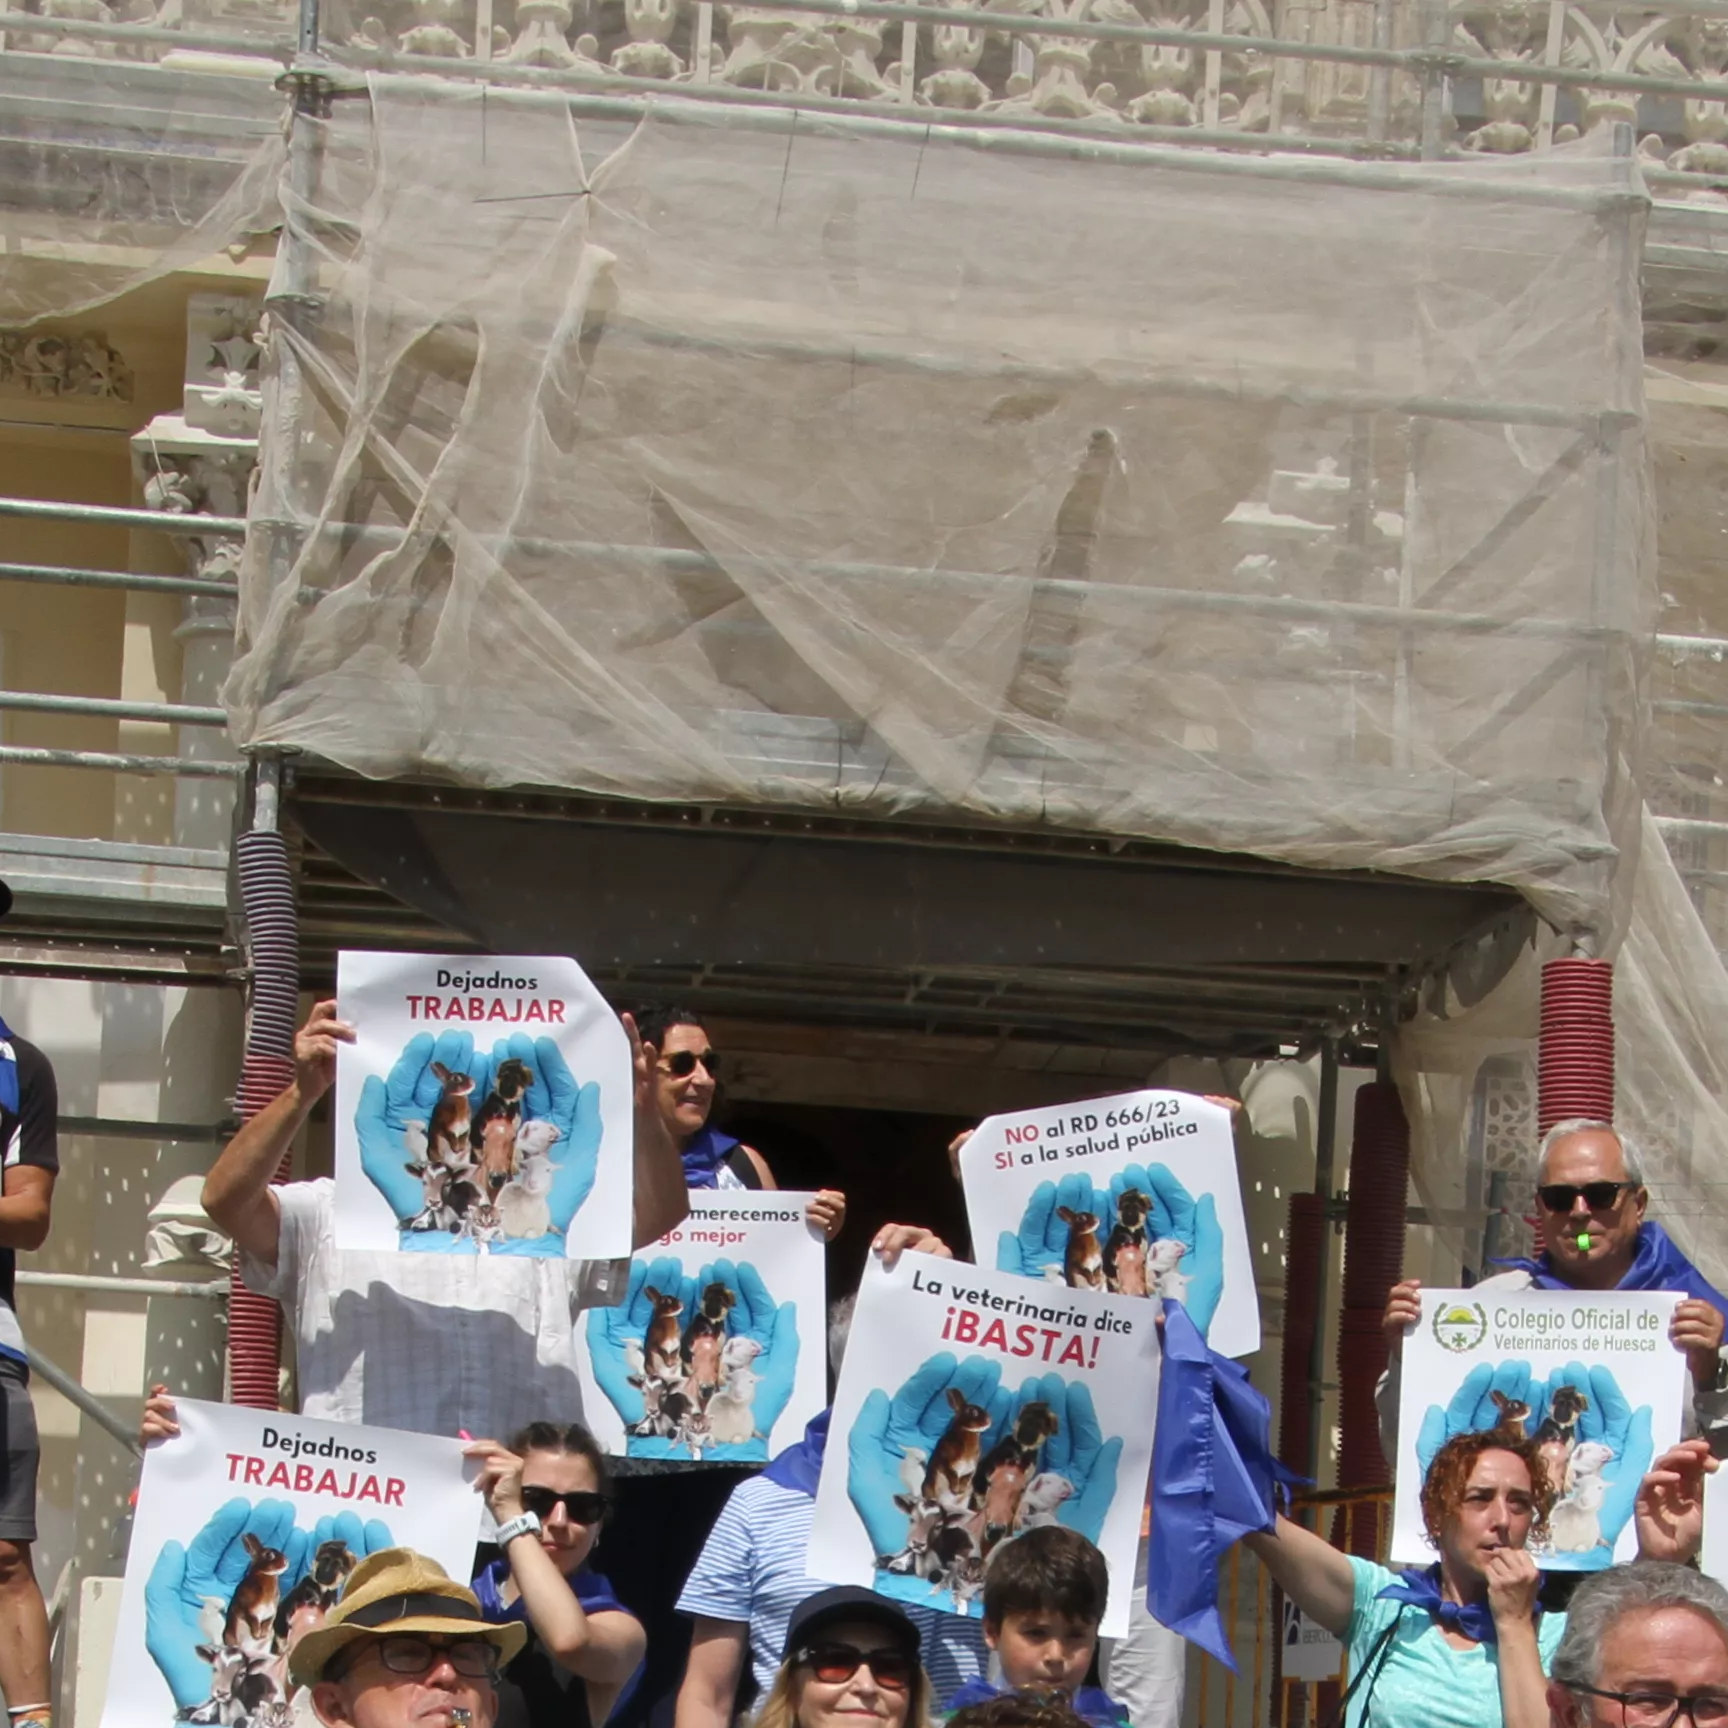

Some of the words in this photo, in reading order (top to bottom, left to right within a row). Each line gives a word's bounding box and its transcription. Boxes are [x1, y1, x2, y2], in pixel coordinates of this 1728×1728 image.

[436, 969, 538, 993] Dejadnos
[406, 995, 566, 1023] TRABAJAR
[1004, 1123, 1040, 1147] NO
[1046, 1117, 1066, 1140] al
[1070, 1115, 1099, 1136] RD
[1105, 1098, 1181, 1130] 666/23
[995, 1150, 1015, 1170] SI
[1020, 1151, 1034, 1166] a
[1038, 1143, 1060, 1164] la
[1065, 1133, 1120, 1160] salud
[1127, 1120, 1199, 1152] pública
[689, 1208, 800, 1222] merecemos
[690, 1226, 747, 1247] mejor
[911, 1269, 942, 1297] La
[952, 1284, 1088, 1330] veterinaria
[1094, 1308, 1133, 1336] dice
[1494, 1307, 1567, 1335] Colegio
[1571, 1308, 1632, 1331] Oficial
[1636, 1309, 1660, 1331] de
[941, 1305, 1101, 1371] ¡BASTA!
[1493, 1334, 1579, 1351] Veterinarios
[1582, 1335, 1600, 1352] de
[1603, 1335, 1657, 1352] Huesca
[261, 1427, 378, 1465] Dejadnos
[225, 1453, 407, 1507] TRABAJAR
